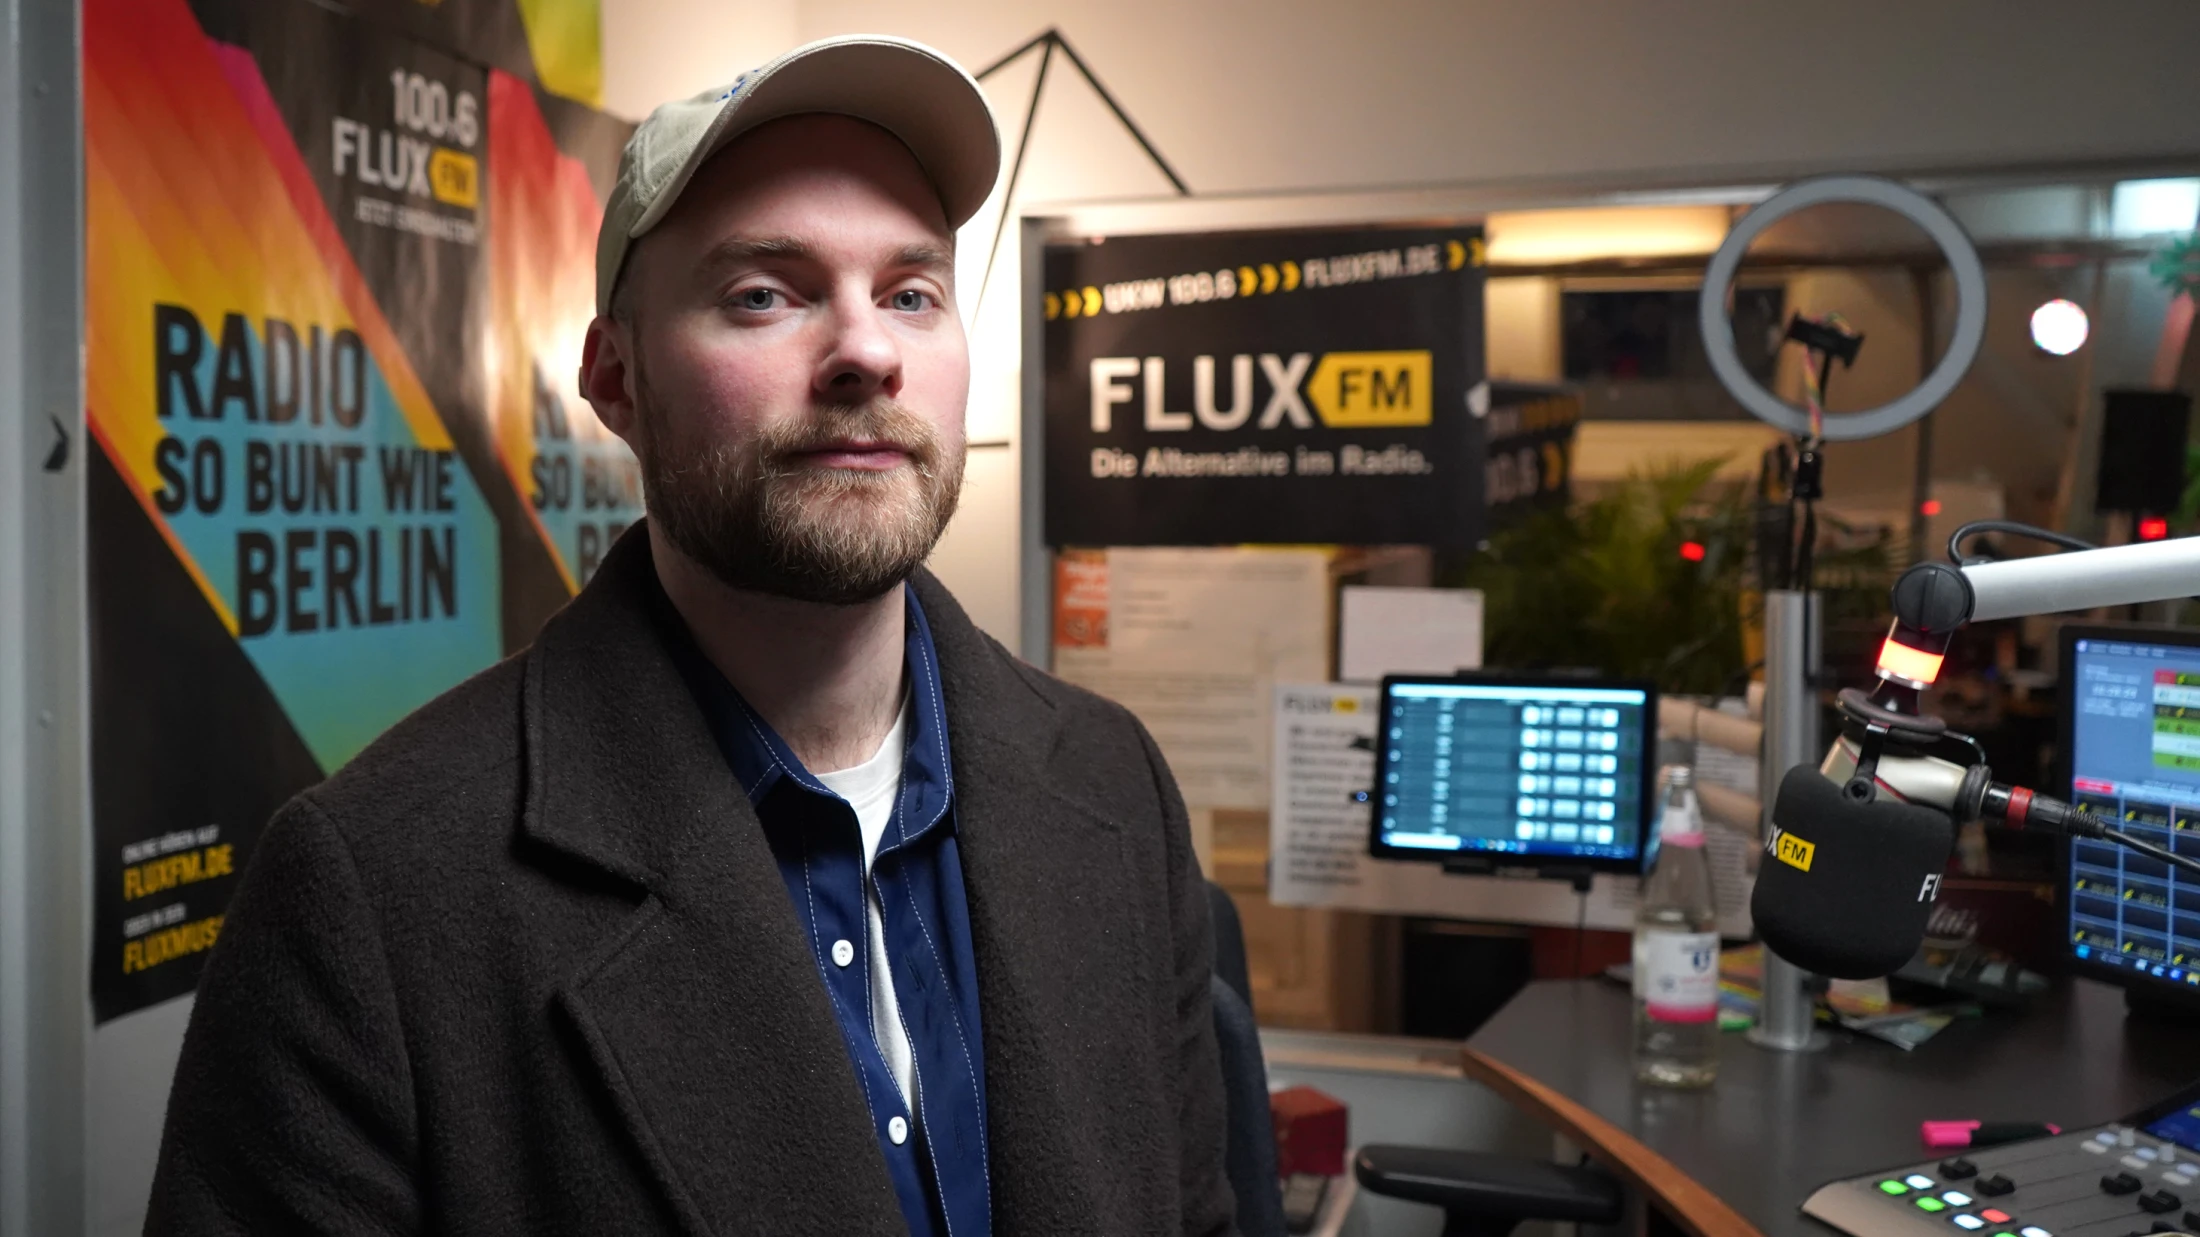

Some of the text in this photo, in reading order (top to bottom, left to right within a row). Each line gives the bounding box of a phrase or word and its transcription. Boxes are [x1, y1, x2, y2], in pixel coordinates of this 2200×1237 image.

[332, 117, 431, 197] FLUX
[1103, 244, 1442, 313] UKW 100.6 FLUXFM.DE
[154, 301, 367, 430] RADIO
[1090, 353, 1412, 433] FLUX FM
[153, 436, 456, 516] SO BUNT WIE
[531, 454, 571, 512] SO
[1091, 443, 1433, 478] Die Alternative im Radio.
[236, 527, 459, 640] BERLIN
[123, 843, 234, 902] FLUXFM.DE
[1783, 838, 1807, 864] FM
